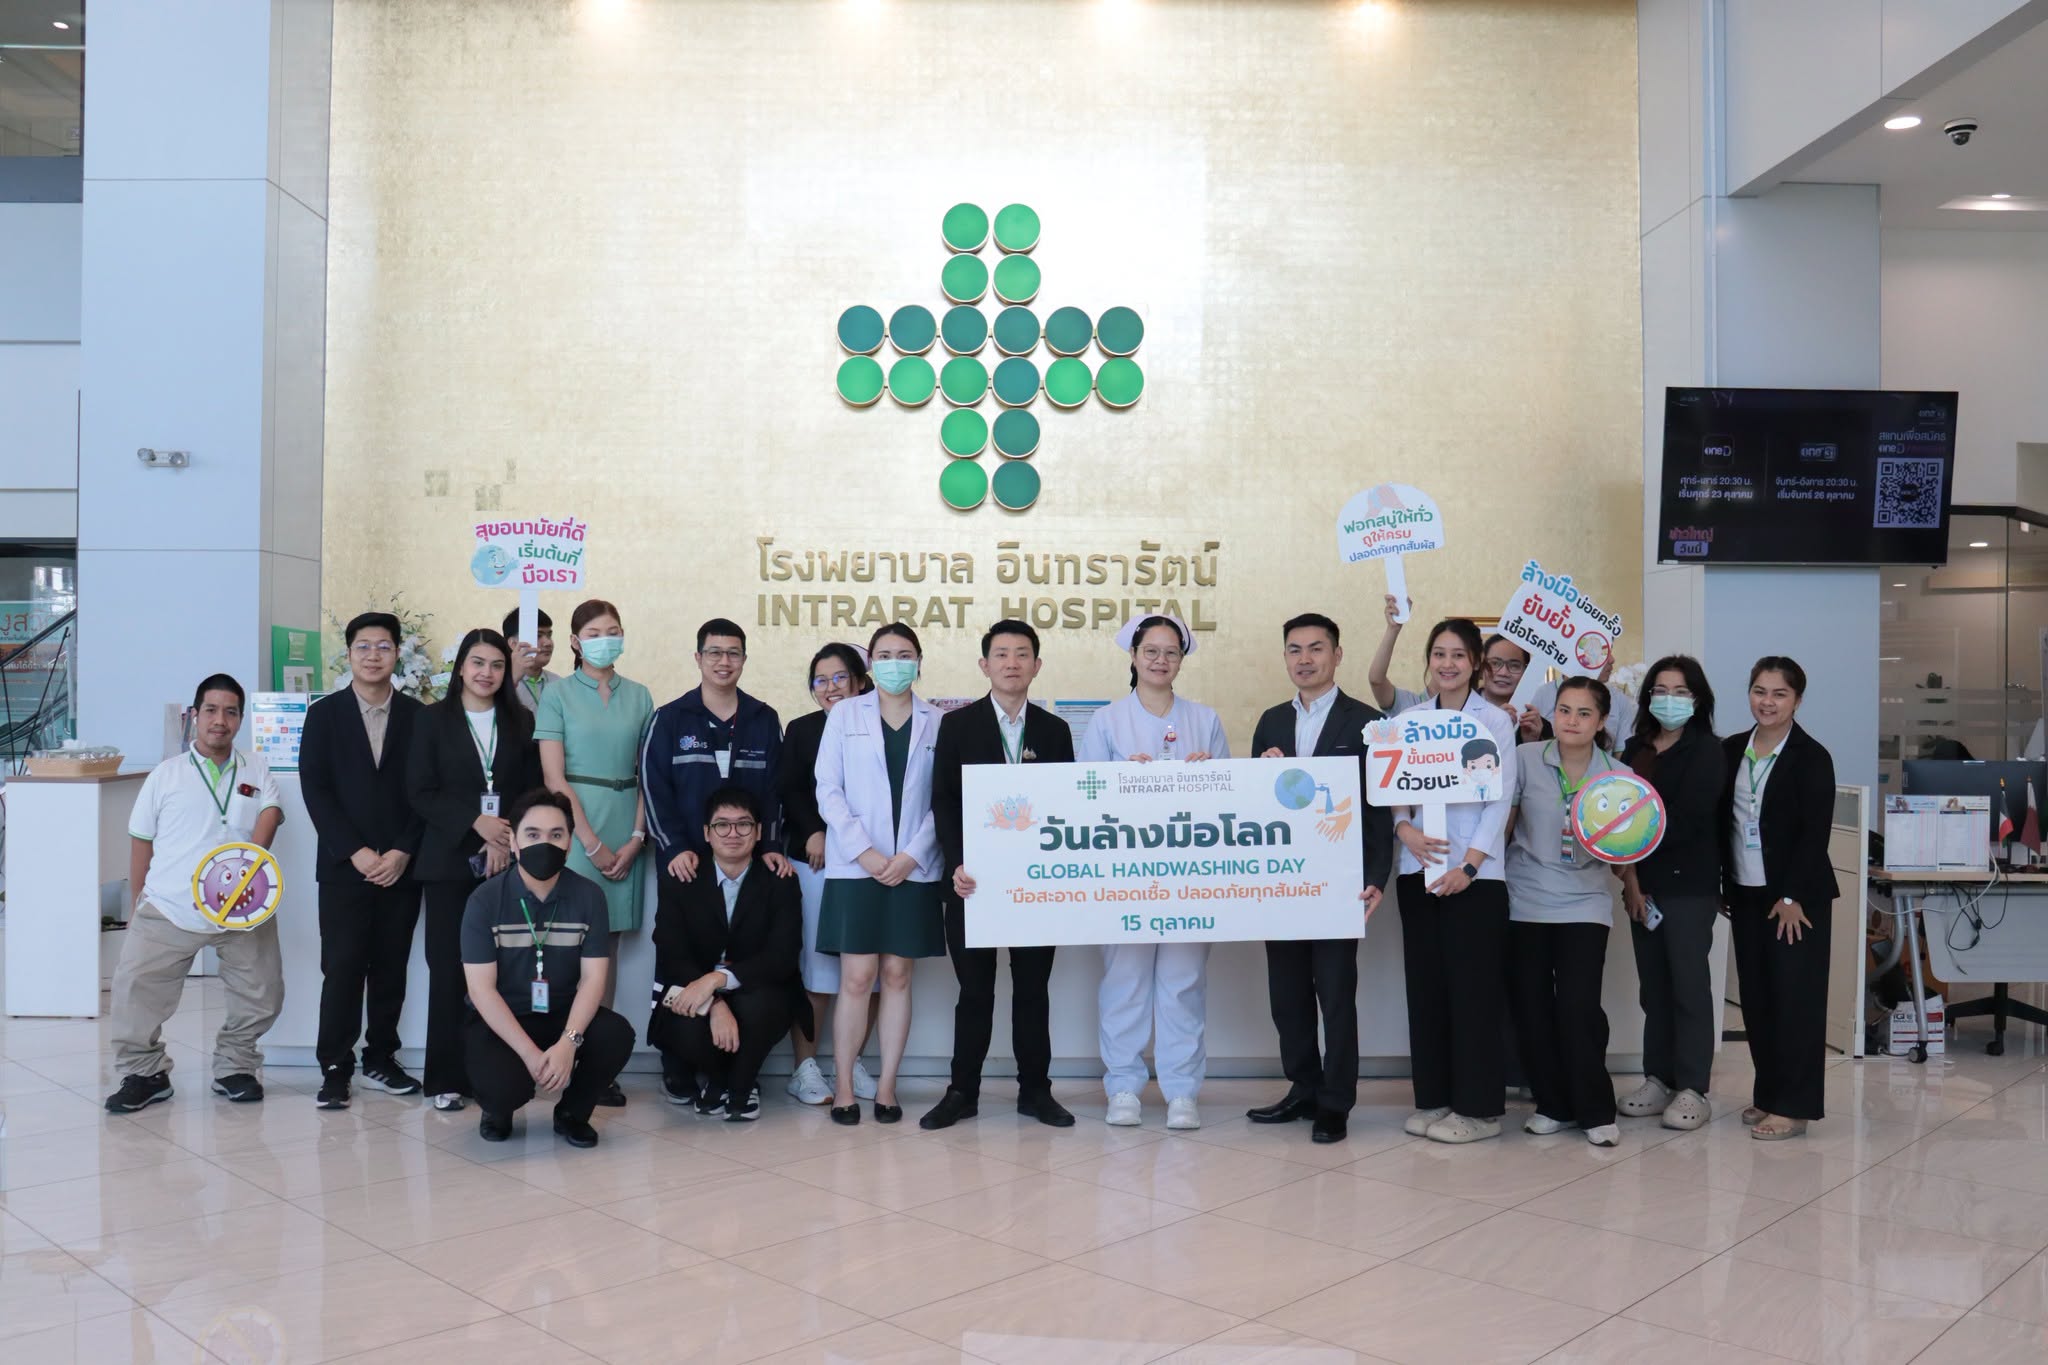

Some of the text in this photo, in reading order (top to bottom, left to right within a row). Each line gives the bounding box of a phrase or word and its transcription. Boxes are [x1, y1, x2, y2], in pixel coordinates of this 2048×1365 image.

[1719, 477, 1743, 486] 20:30
[1825, 478, 1849, 487] 20:30
[1711, 490, 1722, 499] 23
[475, 517, 586, 542] สุขอนามัยที่ดี
[1343, 504, 1433, 534] ฟอกสบู่ให้ทั่ว
[518, 539, 583, 566] เริ่มต้นที่
[757, 537, 1220, 586] โรงพยาบาล อินทรารัตน์
[1349, 540, 1436, 562] ปลอดภัยทุกสัมผัส
[522, 563, 577, 584] มือเรา
[757, 594, 974, 629] INTRARAT
[1522, 593, 1576, 638] ยับยั้ง
[1503, 616, 1568, 665] เชื้อโรคร้าย
[1404, 716, 1477, 744] ล้างมือ
[1118, 772, 1174, 784] โรงพยาบาล
[1373, 748, 1455, 788] 7 ขั้นตอน
[1119, 783, 1235, 794] INTRARAT HOSPITAL
[1397, 771, 1459, 791] ด้วยนะ
[1040, 811, 1291, 851] วันล้างมือโลก
[1027, 858, 1306, 880] GLOBAL HANDWASHING DAY
[1006, 880, 1329, 904] "มือสะอาด ปลอดเชื้อ ปลอดภัยทุกสัมผัส"
[1121, 914, 1216, 937] 15 ตุลาคม
